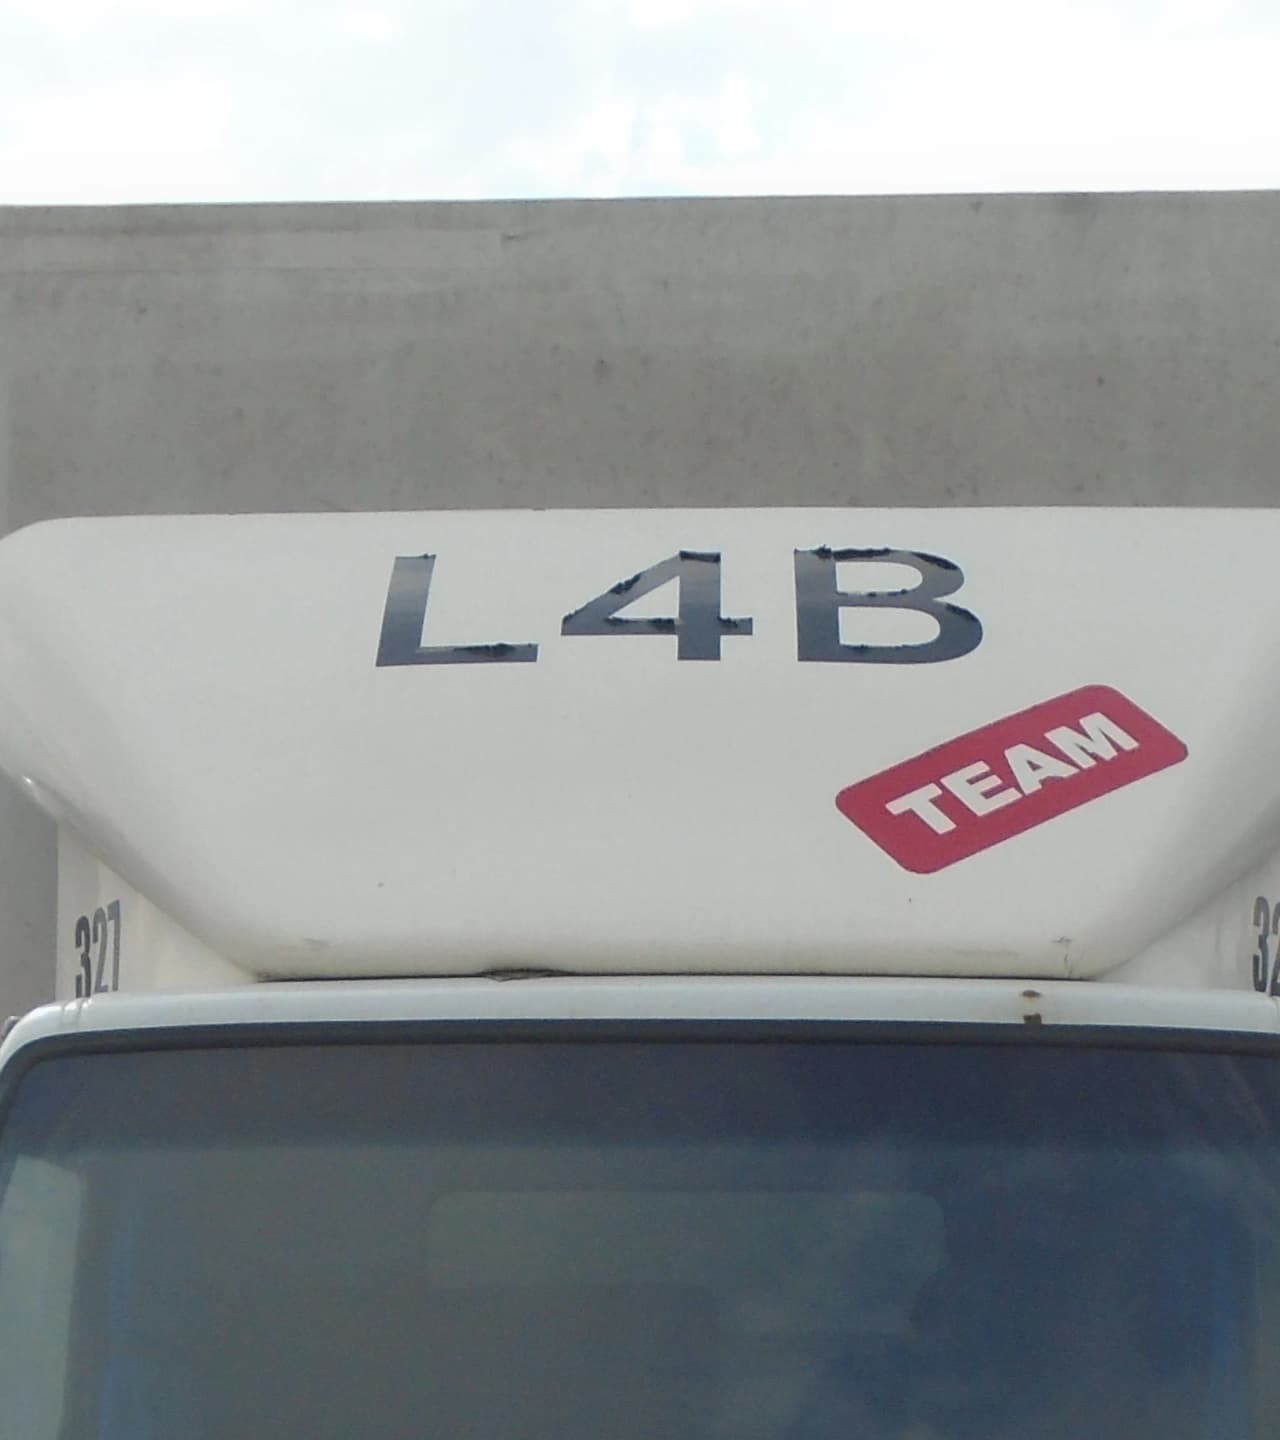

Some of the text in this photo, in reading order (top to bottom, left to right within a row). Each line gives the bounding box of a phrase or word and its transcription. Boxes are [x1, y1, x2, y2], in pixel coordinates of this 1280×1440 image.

[376, 547, 984, 667] L4B
[885, 711, 1139, 837] TEAM
[75, 899, 121, 999] 327
